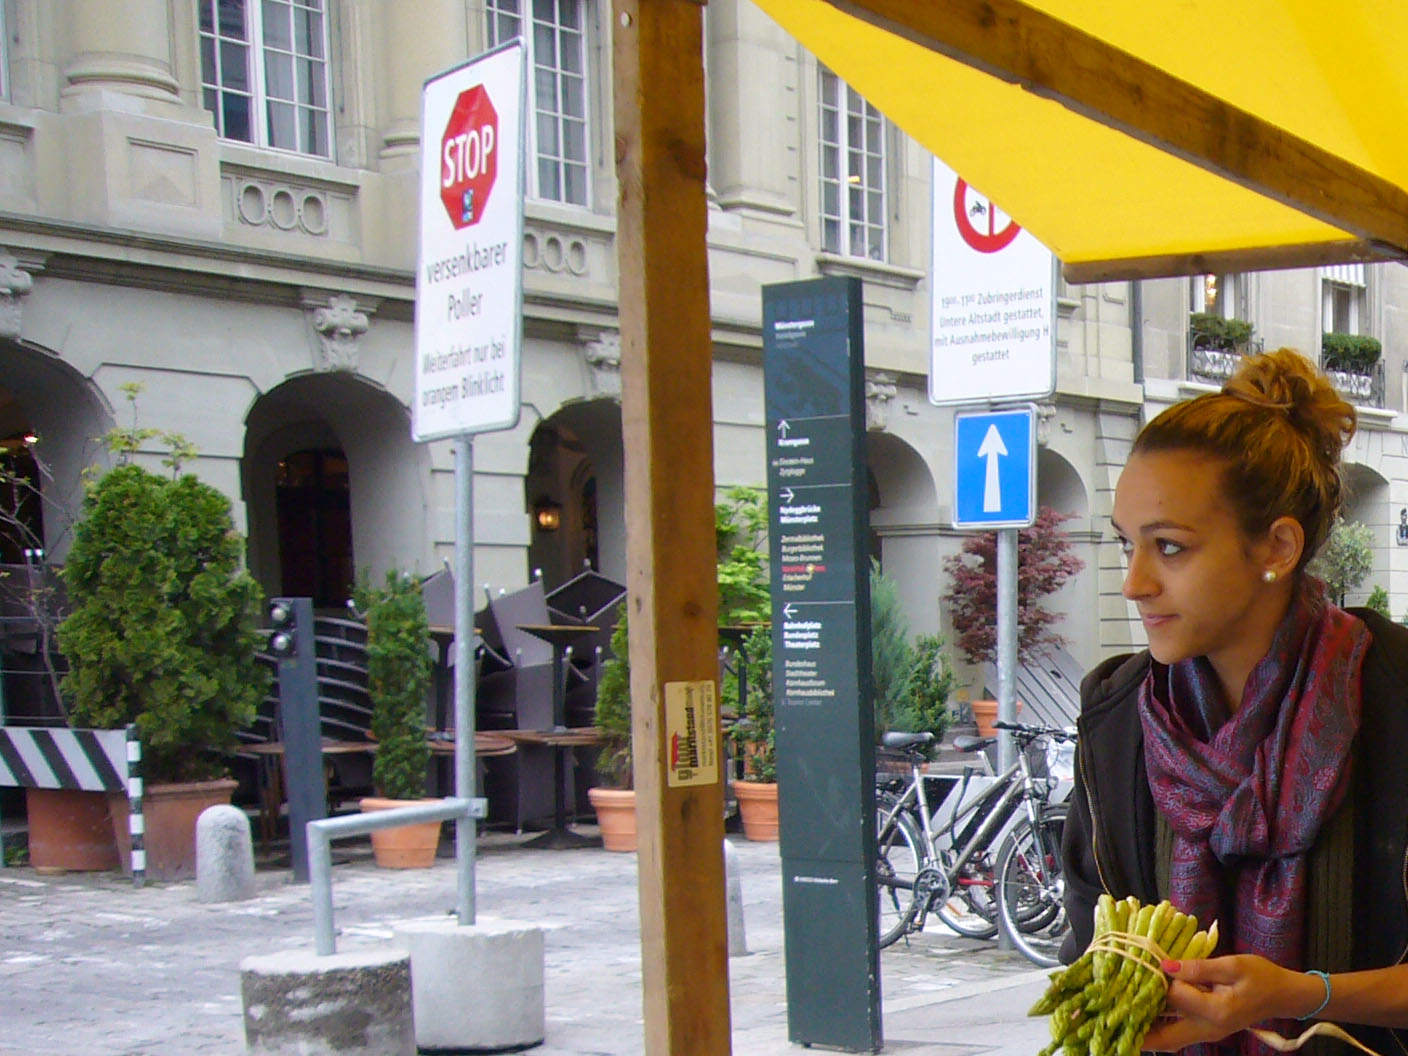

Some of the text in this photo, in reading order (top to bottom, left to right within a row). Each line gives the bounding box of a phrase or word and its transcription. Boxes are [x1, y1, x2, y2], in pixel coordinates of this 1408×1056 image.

[443, 125, 494, 188] STOP
[427, 241, 508, 285] versenkbarer
[448, 288, 483, 321] Poller
[977, 287, 1043, 306] Zubringerdienst
[939, 308, 1044, 328] Untere Altstadt gestattet,
[935, 325, 1050, 346] mit Ausnahmebewilligung H
[422, 336, 506, 375] Weiterfahrt nur bei
[971, 349, 1010, 366] gestattet
[422, 371, 505, 410] orangem Blinklicht
